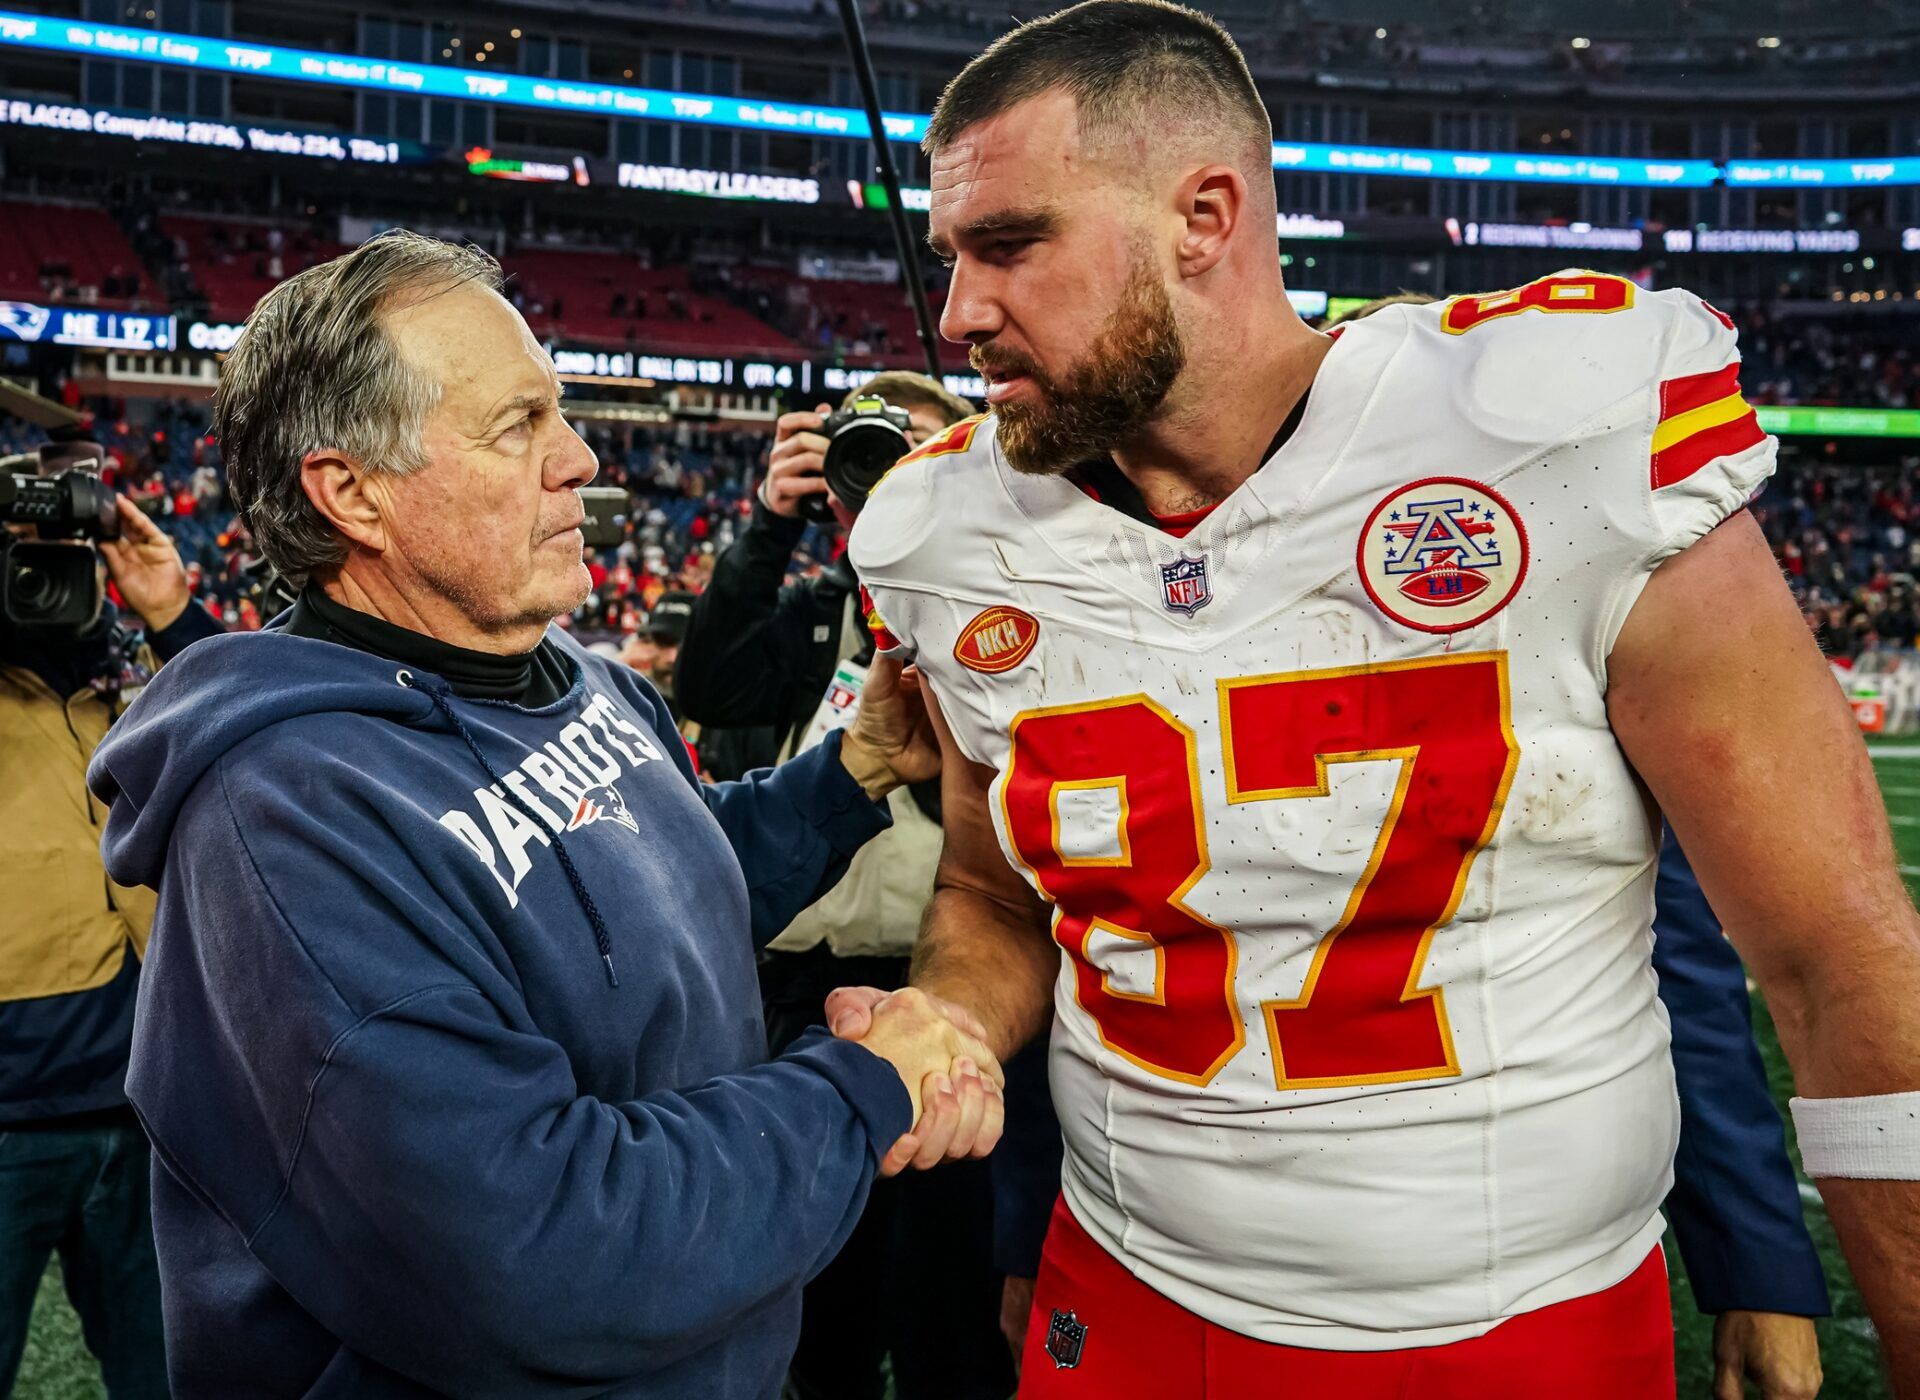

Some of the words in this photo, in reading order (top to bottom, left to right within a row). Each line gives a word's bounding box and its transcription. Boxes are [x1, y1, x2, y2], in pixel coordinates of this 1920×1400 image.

[618, 163, 717, 194] FANTASY
[719, 172, 819, 203] LEADERS
[1384, 498, 1502, 575] A
[1166, 578, 1204, 604] NFL
[1427, 576, 1464, 596] LH
[974, 618, 1022, 660] NKH
[438, 692, 664, 910] PATRIOTS
[1001, 649, 1521, 1091] 87
